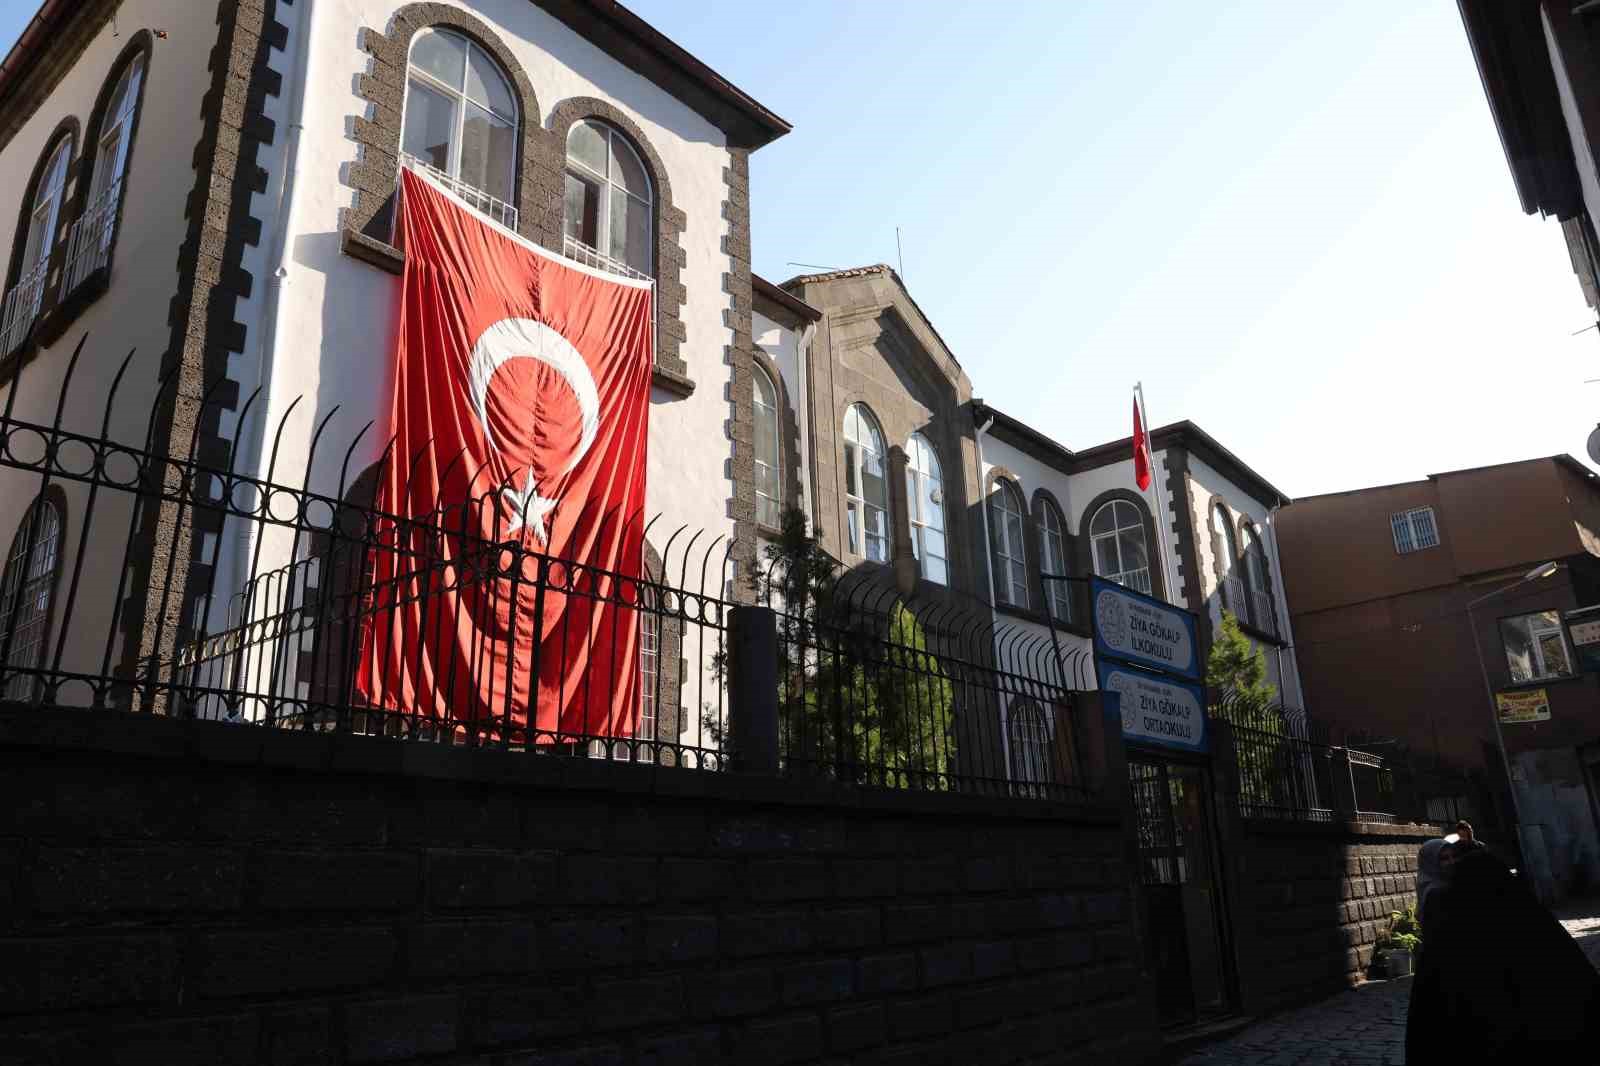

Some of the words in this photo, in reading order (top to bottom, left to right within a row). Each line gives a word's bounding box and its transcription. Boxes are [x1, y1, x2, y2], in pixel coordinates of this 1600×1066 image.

[1149, 621, 1181, 643] GÖKALP
[1131, 635, 1173, 660] İLKOKULU
[1159, 699, 1191, 719] GÖKALP
[1143, 716, 1191, 738] ORTAOKULU
